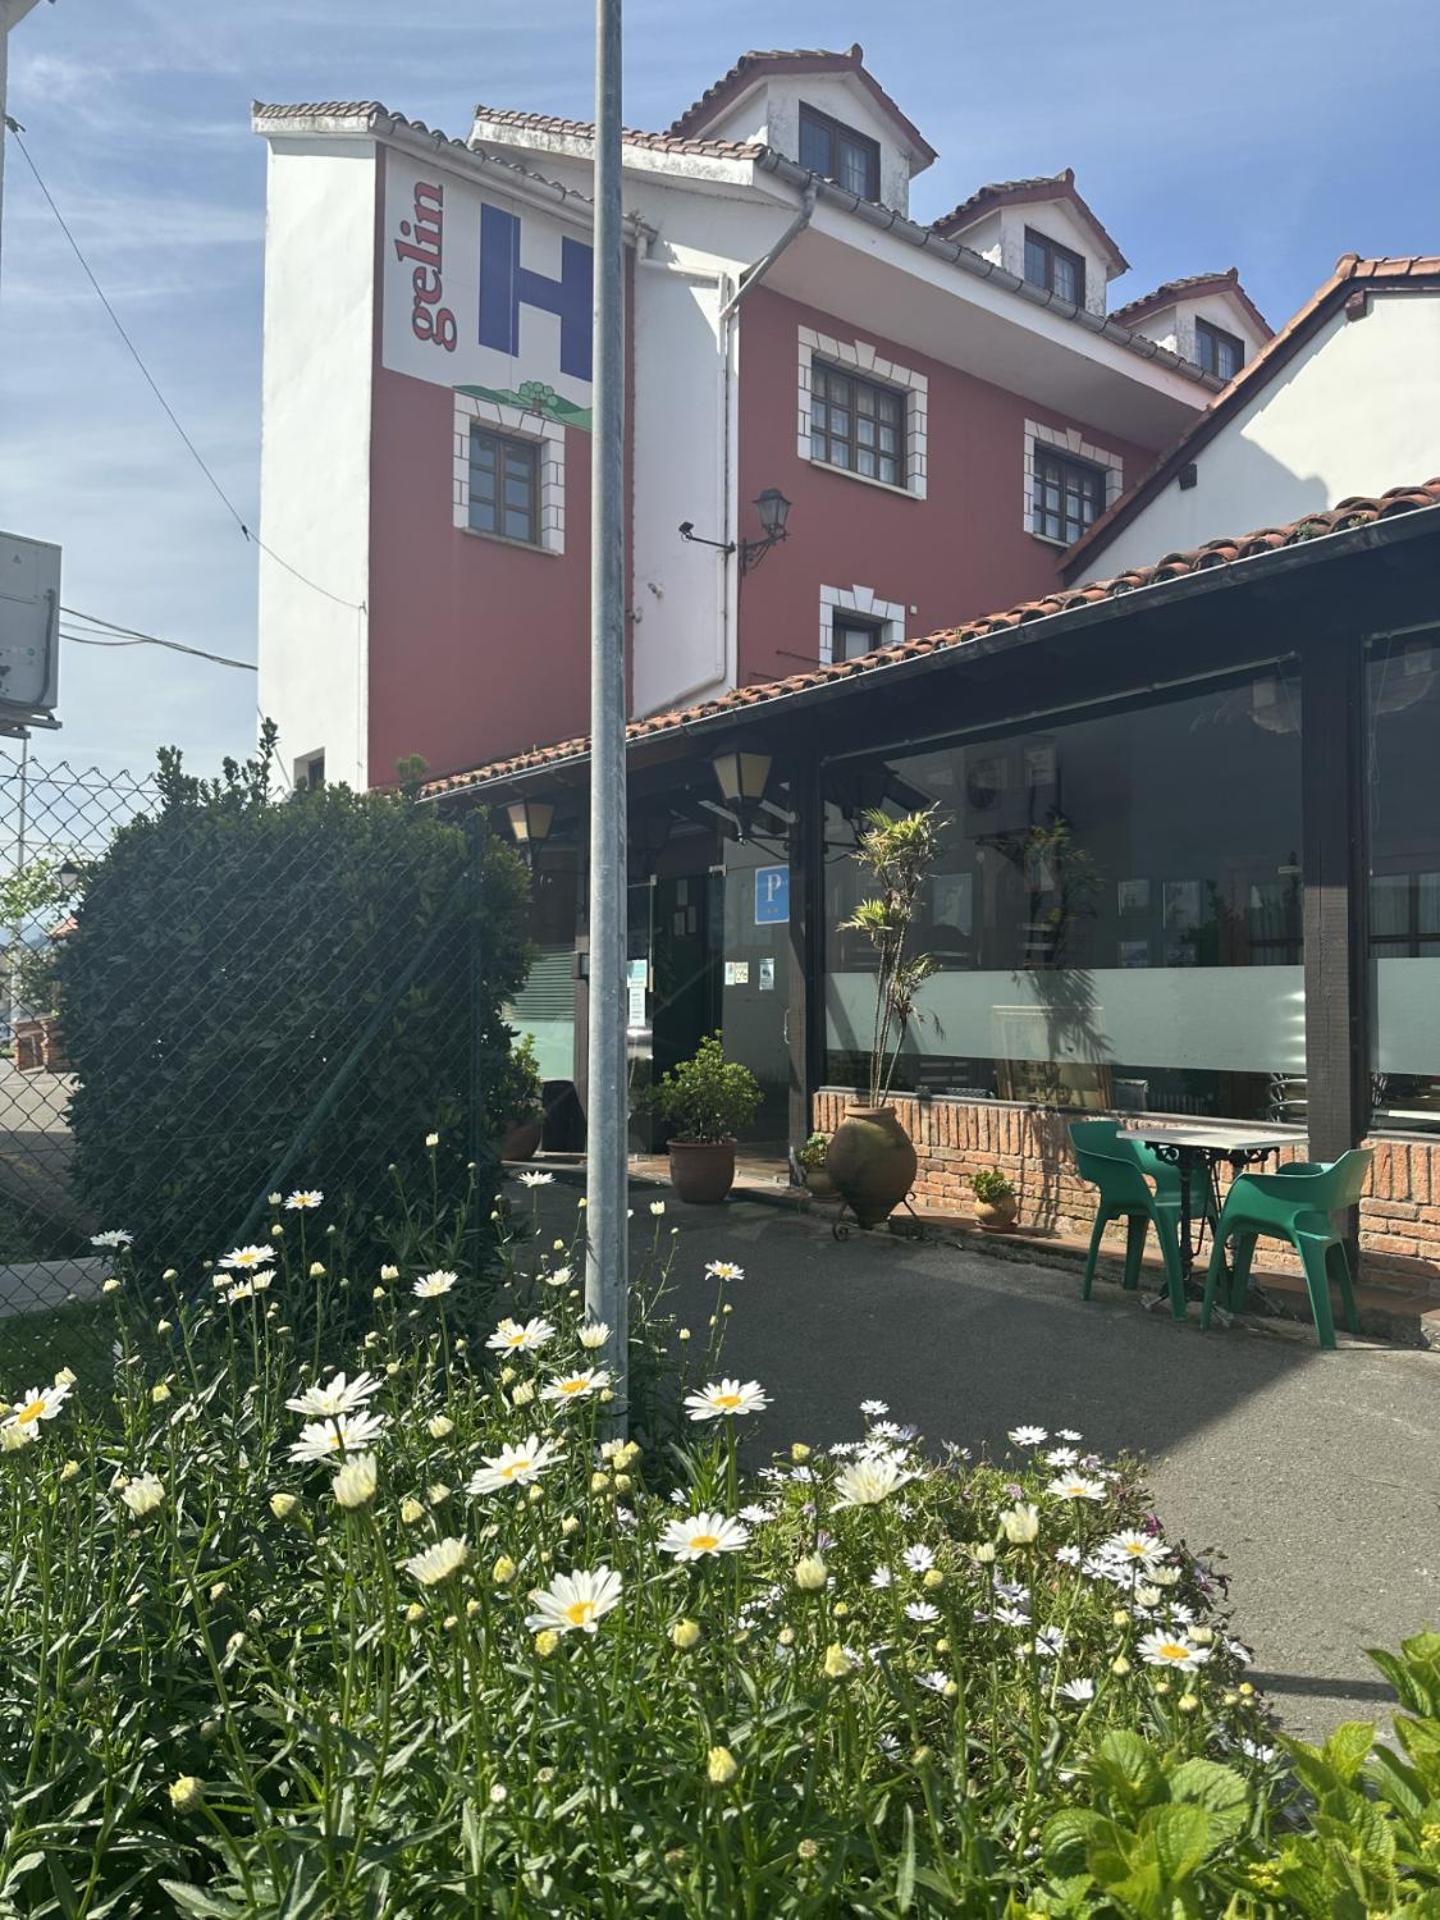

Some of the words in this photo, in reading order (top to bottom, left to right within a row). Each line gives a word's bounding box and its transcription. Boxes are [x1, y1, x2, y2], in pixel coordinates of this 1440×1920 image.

[394, 180, 457, 352] gelin
[479, 202, 594, 383] H
[766, 873, 782, 902] P
